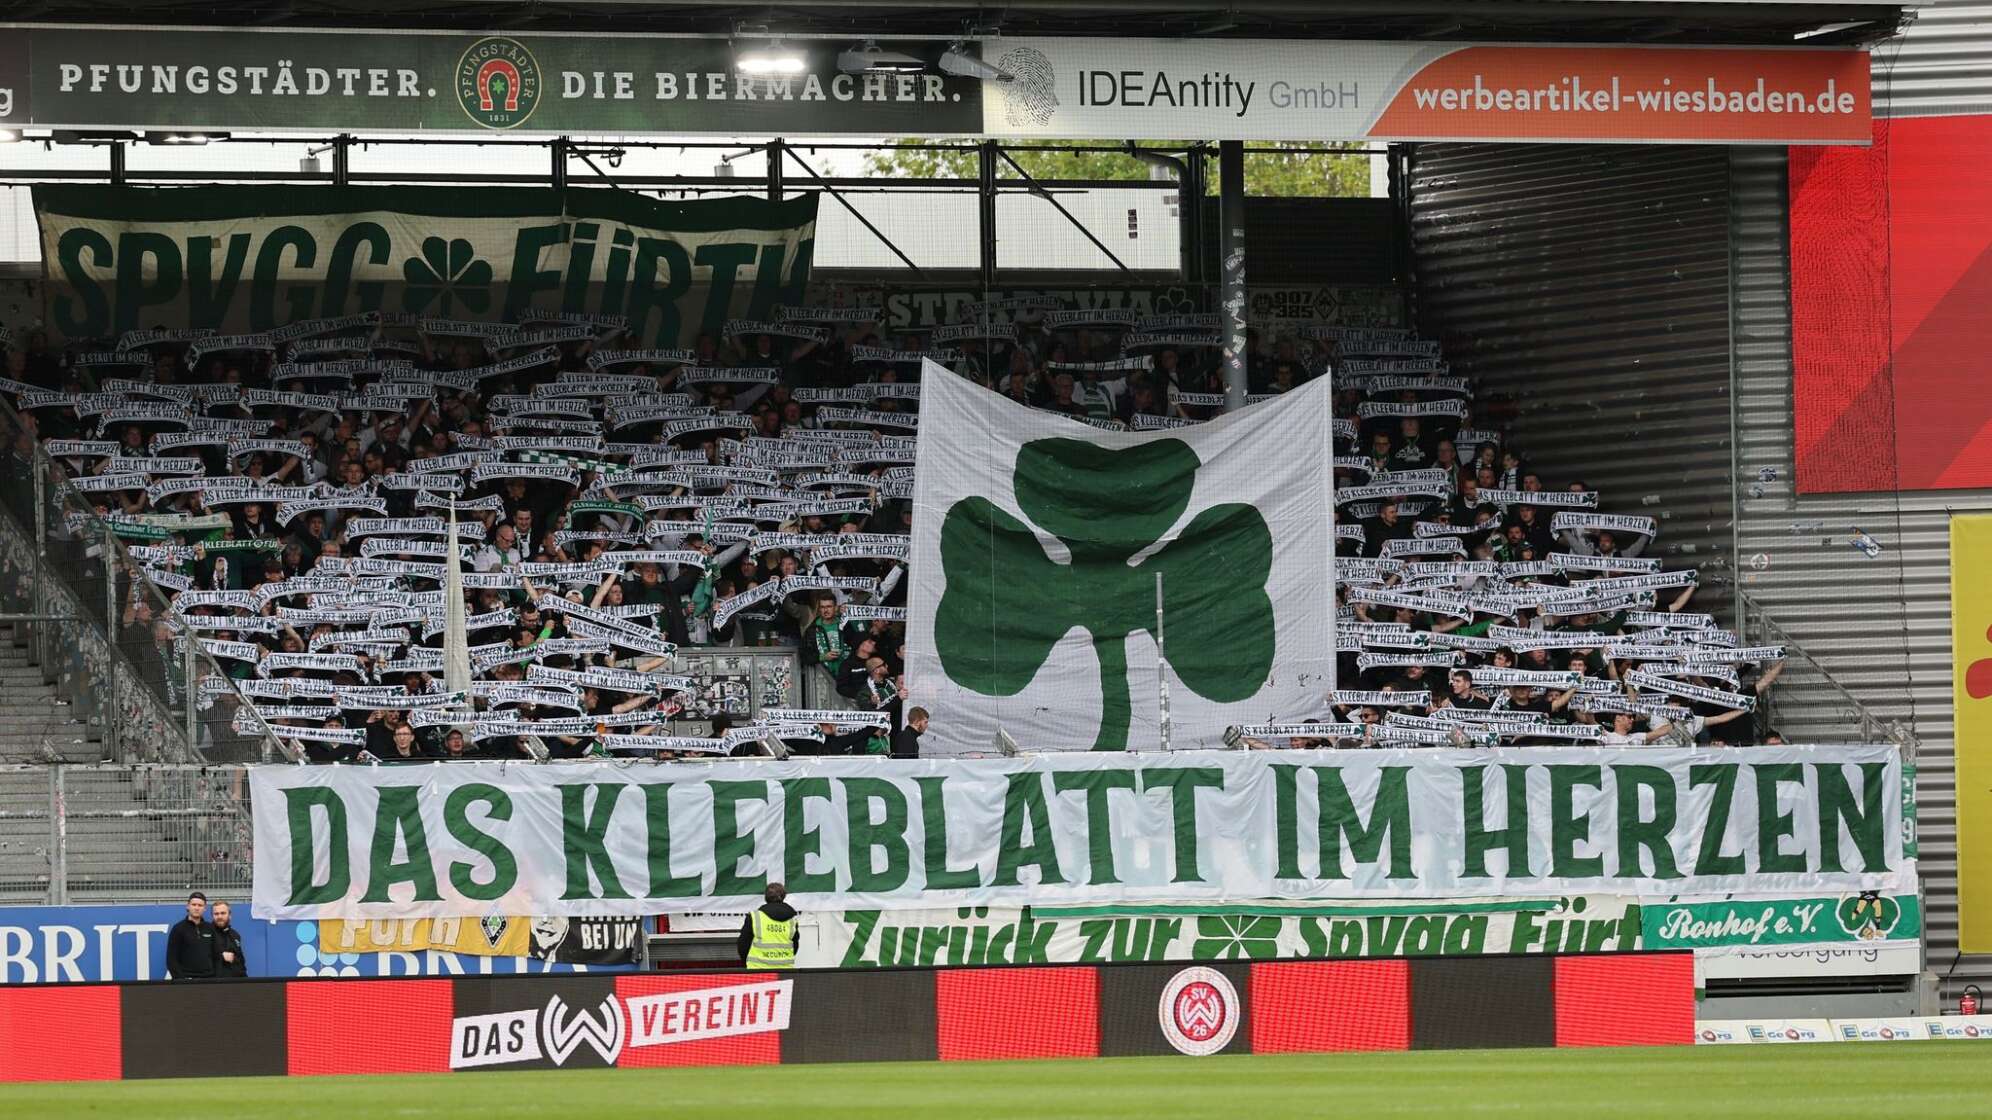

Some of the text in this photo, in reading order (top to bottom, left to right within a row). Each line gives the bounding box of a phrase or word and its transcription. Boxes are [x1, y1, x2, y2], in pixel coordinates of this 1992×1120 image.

[463, 44, 535, 98] PFUNGSTÄDTER
[59, 59, 438, 98] PFUNGSTÄDTER.
[562, 71, 962, 102] DIE BIERMACHER.
[1079, 71, 1359, 117] IDEAntity GmbH
[1413, 76, 1855, 115] werbeartikel-wiesbaden.de
[727, 369, 739, 379] IM
[741, 368, 769, 379] HERZEN
[150, 384, 161, 393] IM
[294, 394, 305, 405] IM
[307, 396, 336, 408] HERZEN
[544, 400, 587, 412] IM HERZEN
[1371, 401, 1458, 414] KLEEBLATT IM HERZEN
[870, 413, 880, 422] IM
[507, 437, 596, 449] KLEEBLATT IM HERZEN
[151, 460, 192, 471] IM HERZEN
[526, 466, 536, 476] IM
[538, 466, 570, 477] HERZEN
[207, 478, 217, 488] IM
[219, 477, 250, 488] HERZEN
[411, 475, 453, 486] IM HERZEN
[217, 489, 307, 501] KLEEBLATT IM HERZEN
[1491, 493, 1580, 504] KLEEBLATT IM HERZEN
[358, 519, 440, 531] KLEEBLATT IM HERZEN
[1558, 514, 1648, 528] KLEEBLATT IM HERZEN
[808, 535, 838, 546] HERZEN
[1424, 541, 1434, 550] IM
[377, 541, 431, 553] KLEEBLATT IM
[655, 553, 701, 563] IM HERZEN
[814, 546, 861, 560] KLEEBLATT
[862, 546, 874, 555] IM
[360, 562, 442, 576] KLEEBLATT IM HERZEN
[573, 562, 584, 572] IM
[585, 560, 617, 572] HERZEN
[1417, 563, 1459, 574] KLEEBLATT
[1461, 563, 1471, 572] IM
[1472, 562, 1495, 572] HERZE
[311, 583, 322, 592] IM
[787, 577, 876, 588] KLEEBLATT IM HERZEN
[1637, 578, 1648, 587] IM
[365, 593, 407, 604] IM HERZEN
[847, 607, 901, 618] KLEEBLATT IM
[1661, 615, 1703, 625] IM HERZEN
[1367, 635, 1412, 645] IM HERZEN
[217, 644, 257, 658] IM HERZE
[1731, 651, 1742, 659] IM
[316, 657, 327, 666] IM
[1475, 671, 1562, 683] LEEBLATT IM HERZEN
[1381, 692, 1392, 702] IM
[832, 712, 843, 722] IM
[1389, 729, 1432, 741] KLEEBLATT
[1545, 725, 1557, 735] IM
[279, 783, 518, 907] DAS
[557, 770, 1223, 900] KLEEBLATT
[1269, 764, 1417, 881] IM
[1456, 763, 1893, 880] HERZEN
[839, 906, 1058, 968] Zurück
[1078, 918, 1183, 962] zur
[1191, 988, 1207, 999] SV
[461, 1016, 525, 1059] DAS
[642, 988, 782, 1037] VEREINT
[1193, 1024, 1207, 1036] 26
